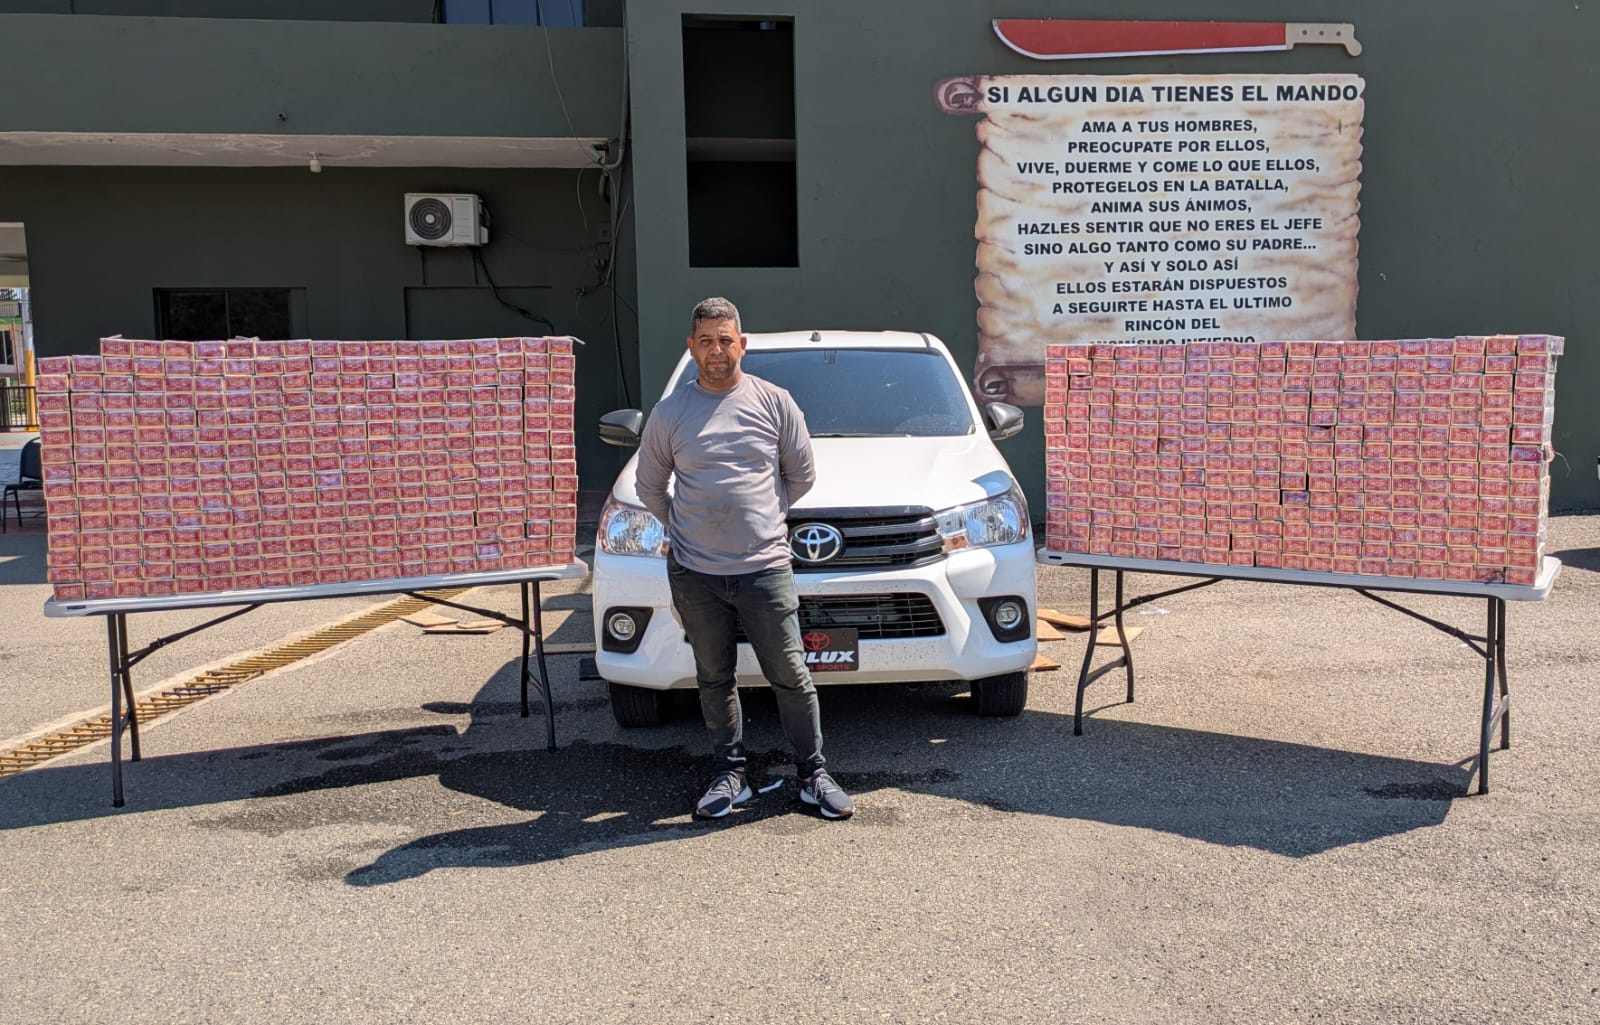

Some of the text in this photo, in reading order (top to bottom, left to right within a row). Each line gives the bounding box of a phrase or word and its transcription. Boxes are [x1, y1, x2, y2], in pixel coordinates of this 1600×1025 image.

[987, 84, 1359, 104] SI ALGUN DIA TIENES EL MANDO
[1081, 119, 1257, 134] AMA A TUS HOMBRES,
[1068, 139, 1270, 154] PREOCUPATE POR ELLOS,
[1017, 158, 1320, 176] VIVE, DUERME Y COME LO QUE ELLOS,
[1052, 178, 1289, 194] PROTEGELOS EN LA BATALLA,
[1090, 196, 1252, 214] ANIMA SUS ÁNIMOS,
[1018, 218, 1322, 235] HAZLES SENTIR QUE NO ERES EL JEFE
[1024, 238, 1316, 256] SINO ALGO TANTO COMO SU PADRE...
[1104, 257, 1238, 273] Y ASÍ Y SOLO ASÍ
[1056, 276, 1287, 295] ELLOS ESTARÁN DISPUESTOS
[1052, 296, 1292, 314] A SEGUIRTE HASTA EL ULTIMO
[1125, 317, 1221, 332] RINCÓN DEL
[804, 651, 856, 664] LUX
